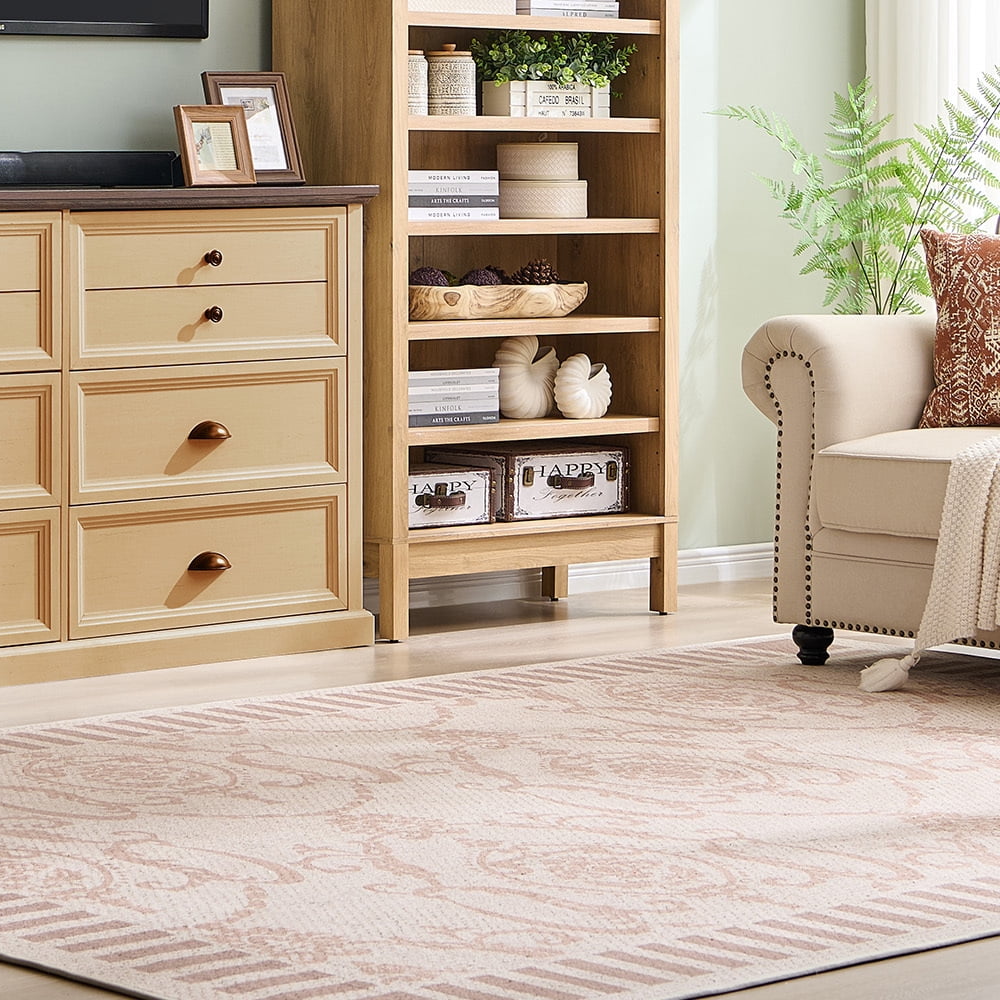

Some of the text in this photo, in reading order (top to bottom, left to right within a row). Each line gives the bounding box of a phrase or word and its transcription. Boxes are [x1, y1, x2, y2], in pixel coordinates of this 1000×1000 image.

[564, 95, 585, 105] BRASIL
[434, 404, 463, 412] KINFOLK
[453, 415, 472, 423] CRAFTS
[533, 463, 608, 478] HAPPY
[408, 480, 477, 495] HAPY
[532, 487, 604, 503] Together
